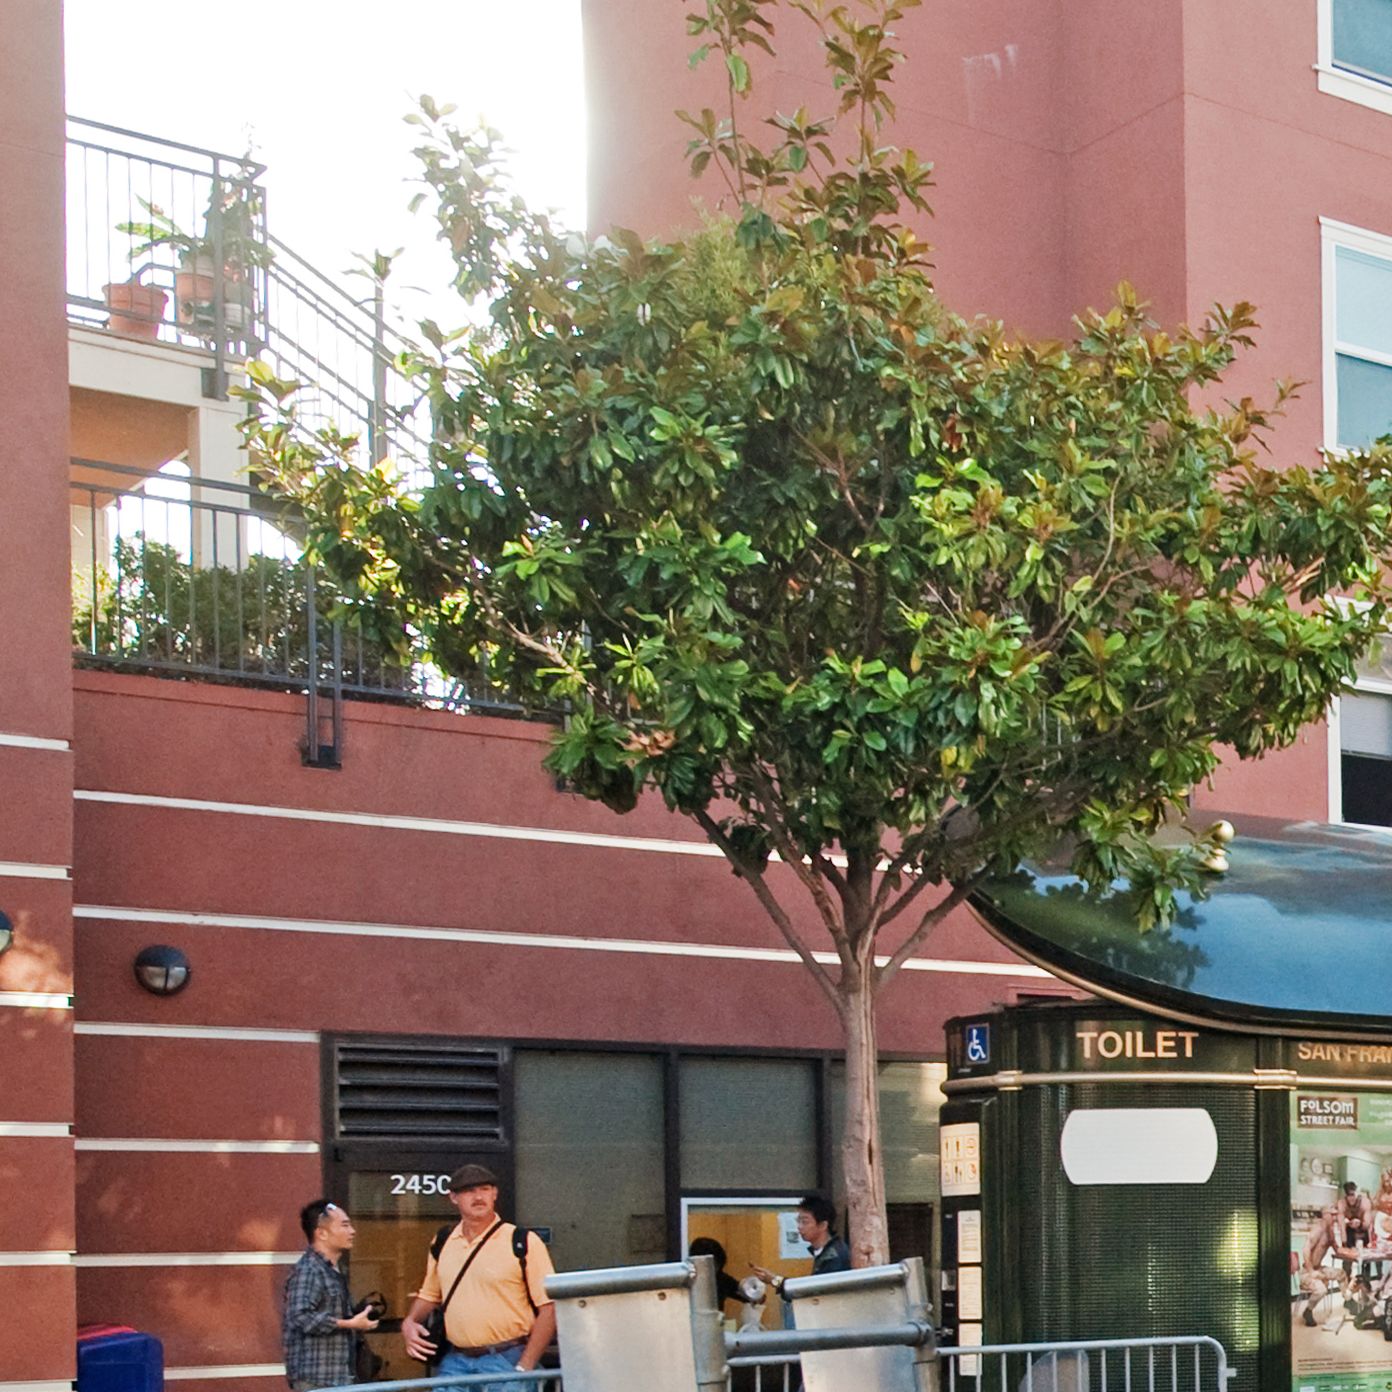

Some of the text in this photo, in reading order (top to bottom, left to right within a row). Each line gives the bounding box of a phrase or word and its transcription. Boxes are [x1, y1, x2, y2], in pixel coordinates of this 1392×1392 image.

[1076, 1031, 1199, 1058] TOILET
[1300, 1115, 1356, 1126] STREET FAIR
